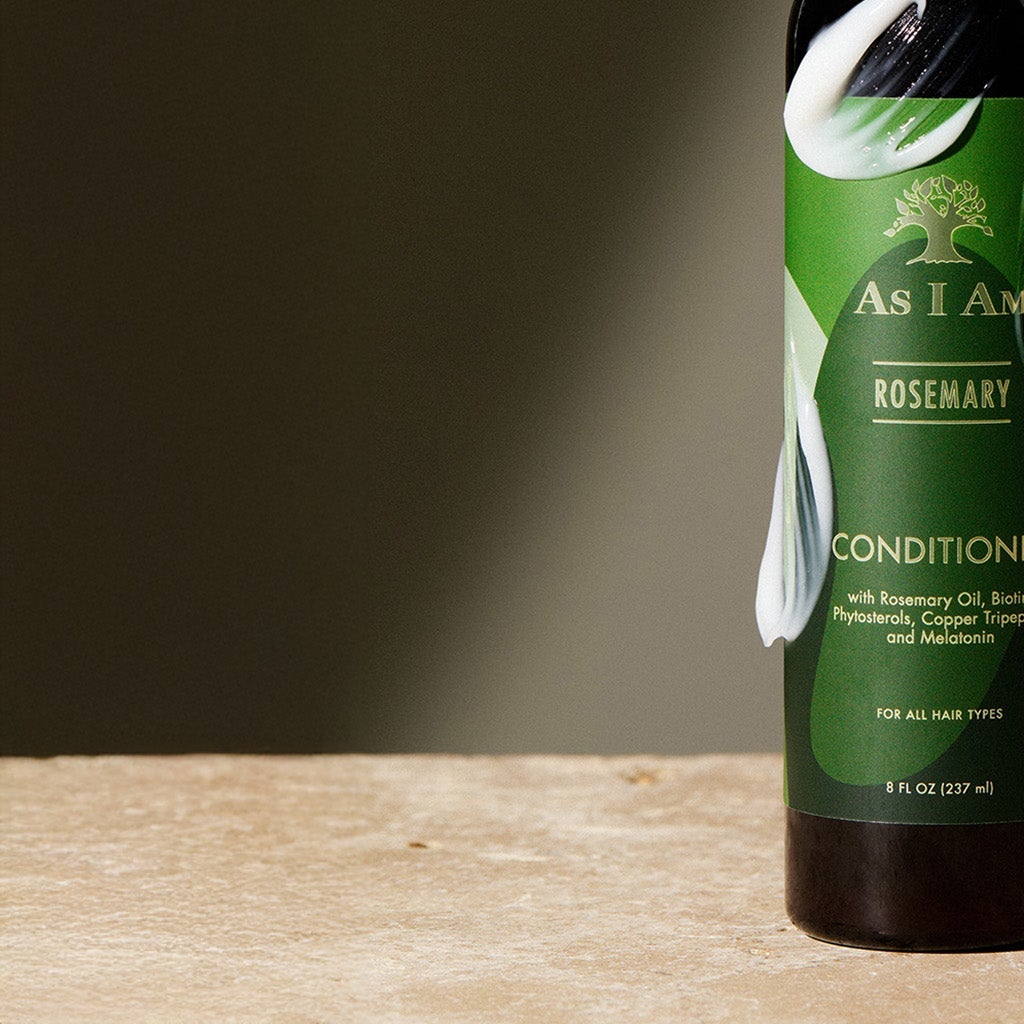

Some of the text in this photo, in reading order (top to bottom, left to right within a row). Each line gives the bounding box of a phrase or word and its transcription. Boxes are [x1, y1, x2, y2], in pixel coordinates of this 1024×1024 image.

[927, 282, 947, 316] I
[875, 379, 1010, 409] ROSEMARY
[847, 591, 875, 604] with
[880, 592, 953, 609] Rosemary
[957, 592, 986, 609] Oil,
[833, 607, 915, 627] Phytosterols,
[921, 612, 978, 629] Copper
[887, 630, 995, 645] and Melatonin
[877, 708, 1003, 720] FOR ALL HAIR TYPES
[886, 780, 994, 795] 8 FL OZ (237 ml)
